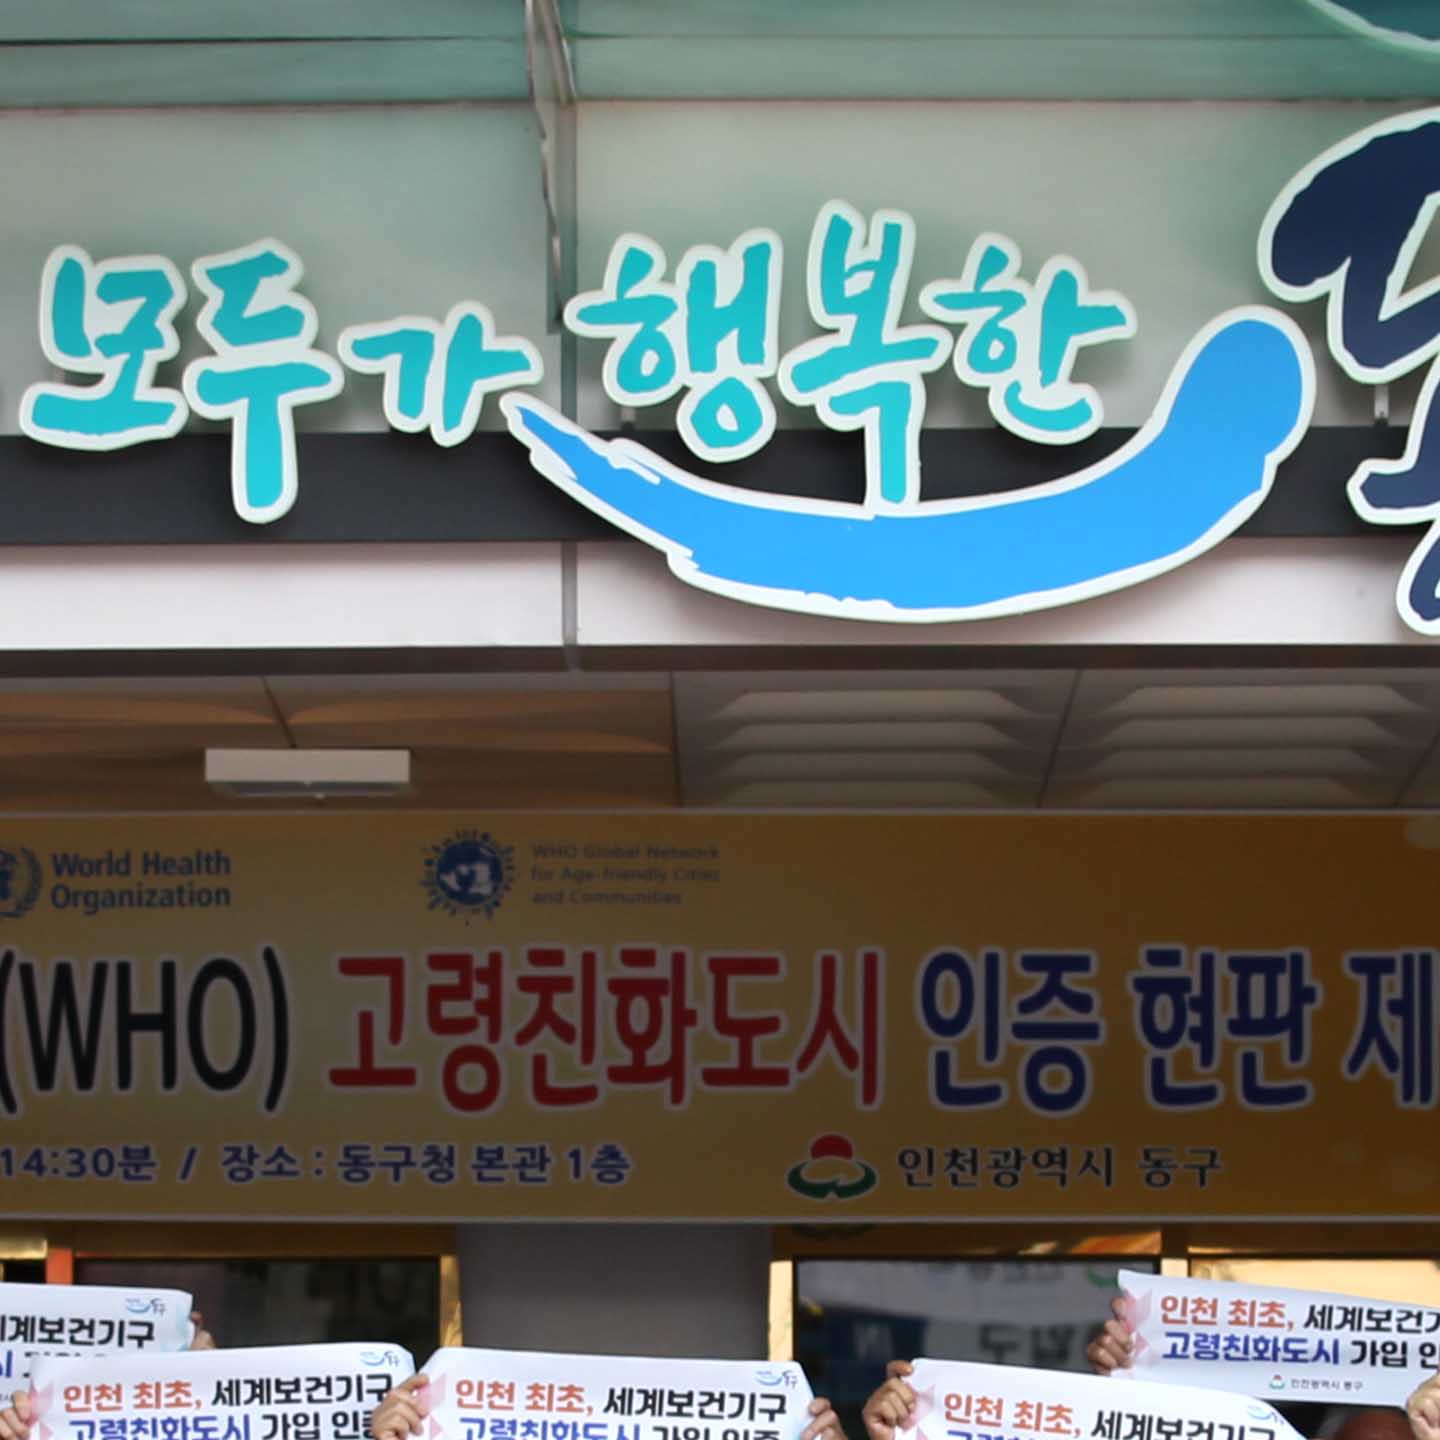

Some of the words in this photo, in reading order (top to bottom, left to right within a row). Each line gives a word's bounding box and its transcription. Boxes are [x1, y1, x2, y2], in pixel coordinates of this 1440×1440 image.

[28, 248, 532, 510] 모두가
[574, 210, 1130, 502] 행복한
[51, 850, 130, 877] World
[144, 849, 231, 876] Health
[533, 844, 577, 859] WHO
[583, 844, 640, 859] Global
[647, 844, 720, 859] Network
[531, 865, 554, 881] for
[674, 866, 721, 881] Cities
[51, 882, 231, 915] Organization
[533, 890, 562, 905] and
[565, 890, 682, 905] Communities
[327, 947, 880, 1112] 고령친화도시
[921, 950, 1102, 1111] 인증
[1131, 948, 1316, 1110] 현판
[0, 1143, 156, 1182] 14:30분
[336, 1143, 457, 1184] 동구청
[470, 1144, 552, 1184] 본관
[567, 1143, 632, 1184] 1층
[897, 1145, 1114, 1189] 인천광역시
[1137, 1147, 1222, 1189] 동구
[456, 1380, 515, 1410] 인천
[525, 1382, 593, 1416] 최초,
[603, 1387, 787, 1423] 세계보건기구
[944, 1393, 1003, 1427] 인천
[1012, 1400, 1080, 1438] 최초,
